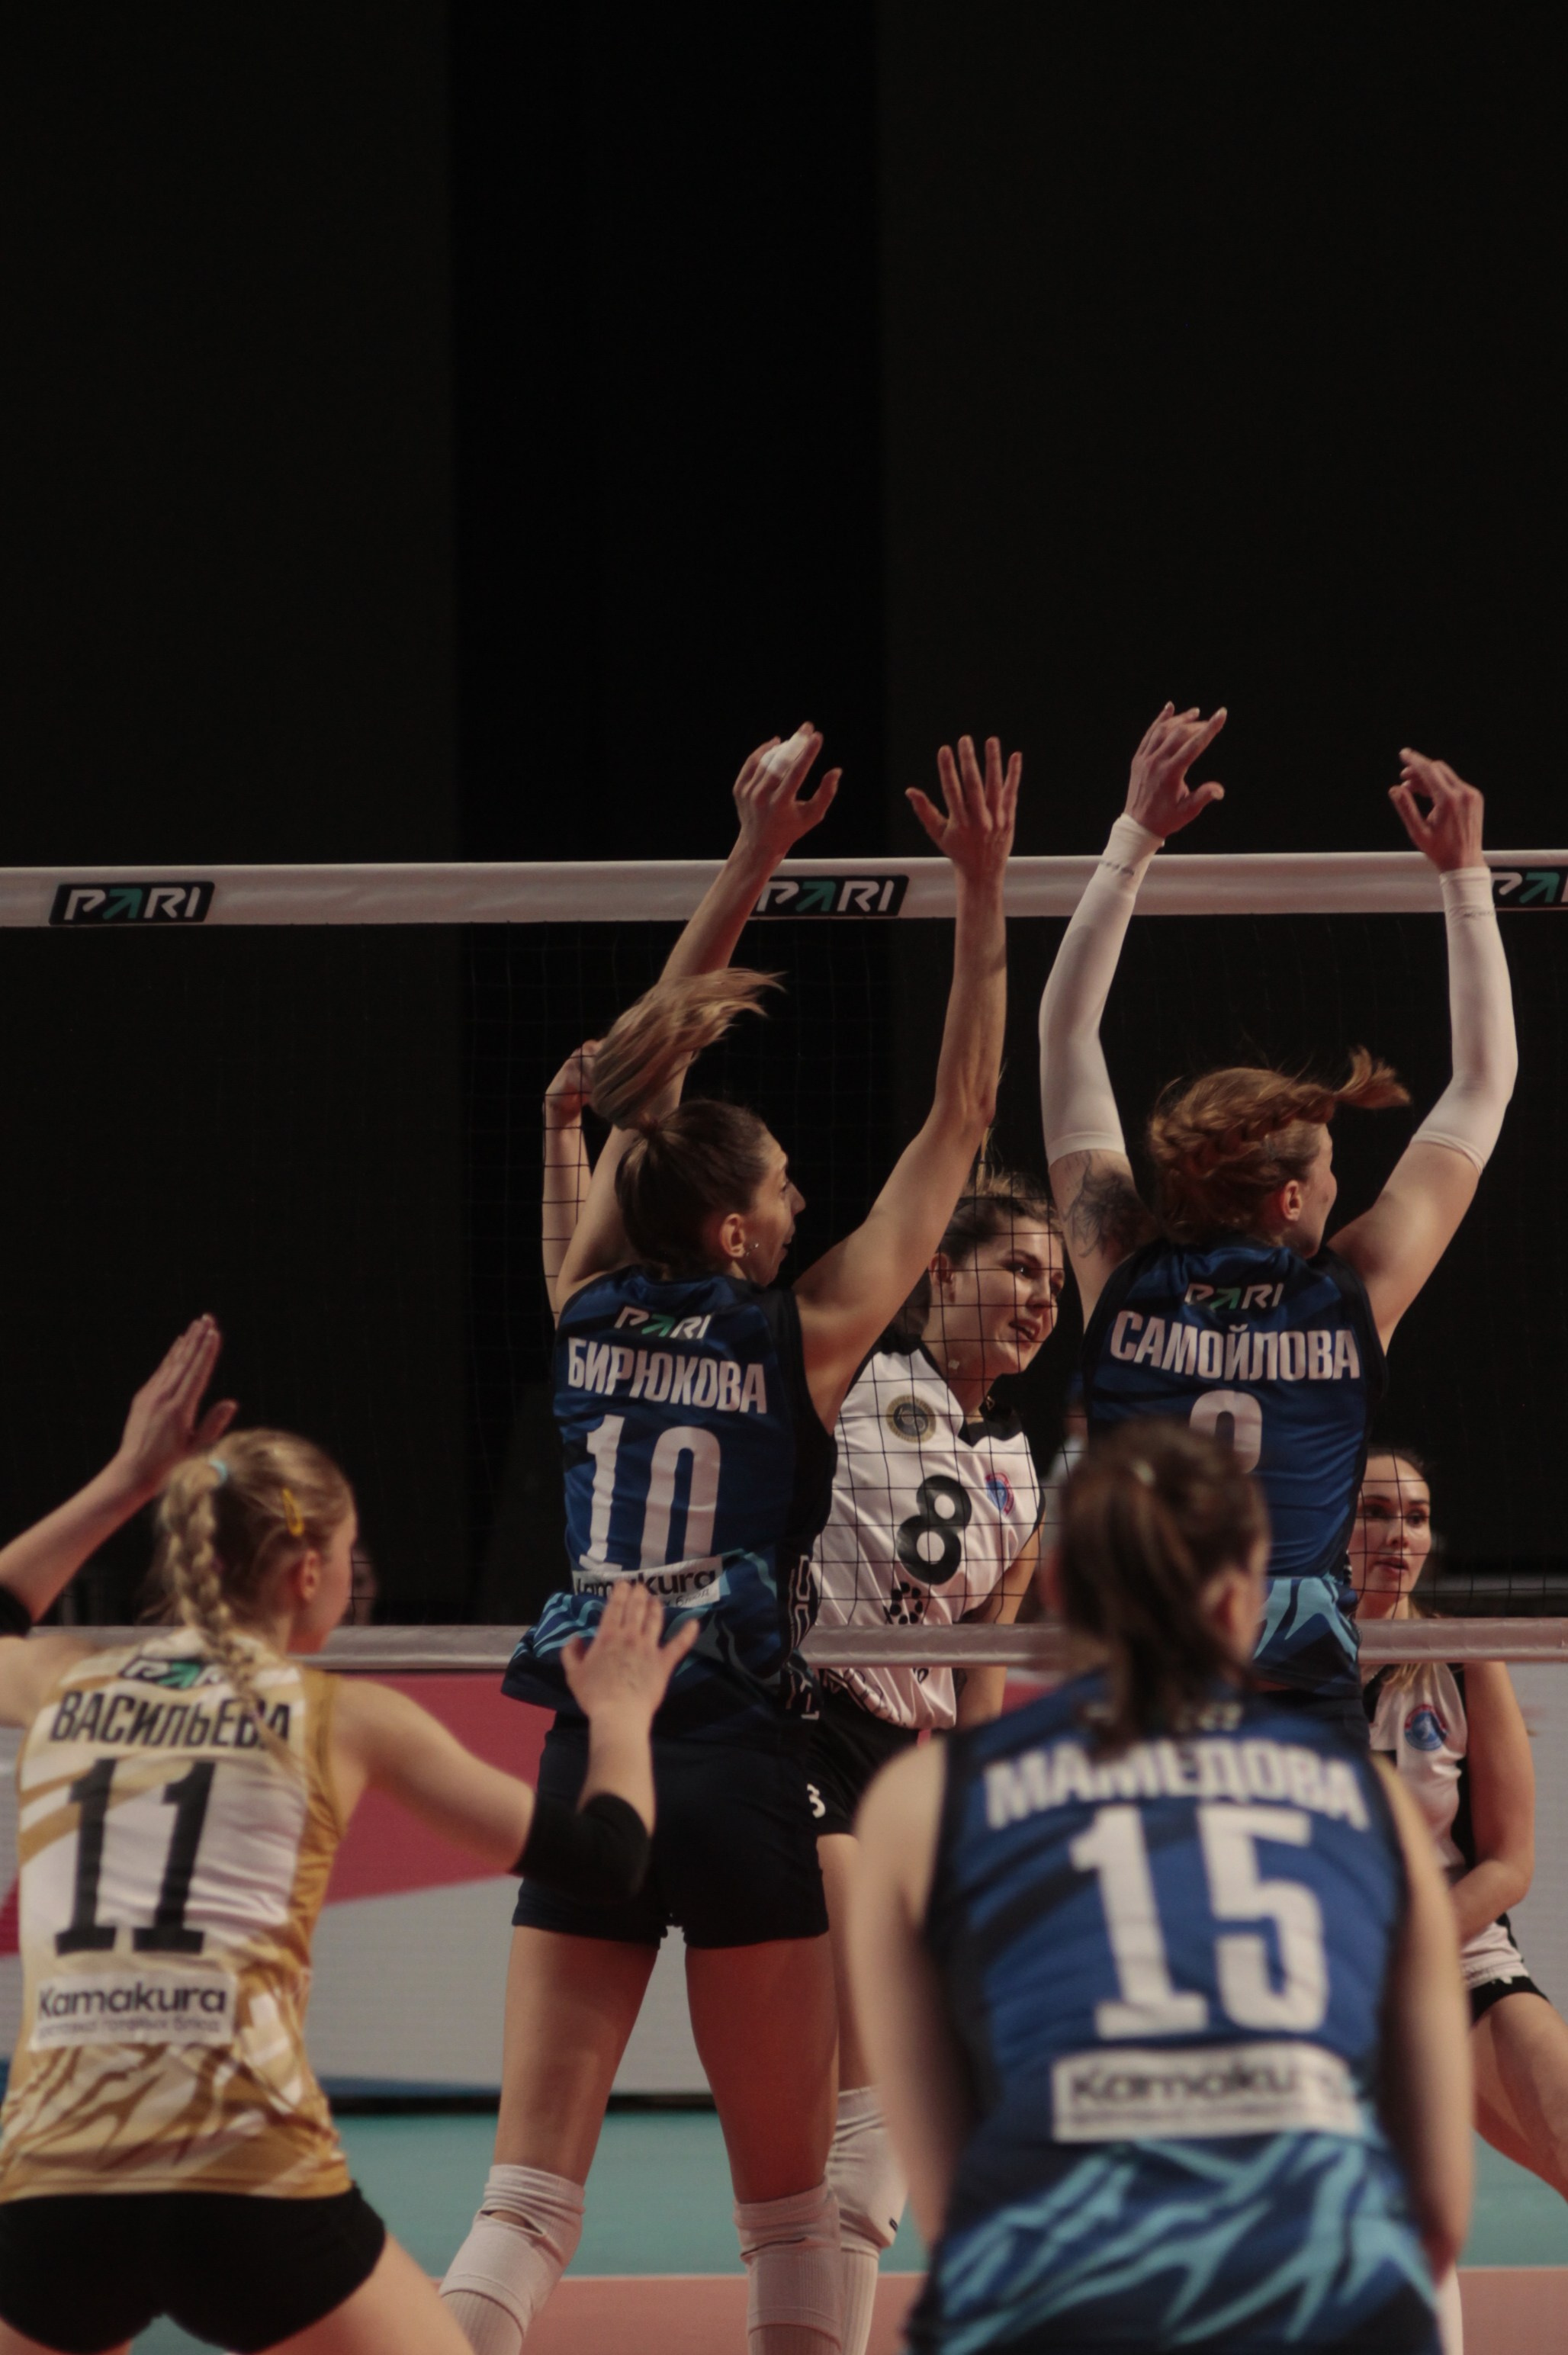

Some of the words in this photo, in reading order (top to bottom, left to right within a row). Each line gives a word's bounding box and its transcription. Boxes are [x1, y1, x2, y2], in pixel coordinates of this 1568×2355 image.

[64, 887, 201, 920] PARI
[756, 880, 895, 913] PARI
[1491, 872, 1568, 904] PA
[614, 1306, 713, 1340] PARI
[1184, 1283, 1285, 1311] PARI
[1110, 1309, 1361, 1381] САМОЙЛОВА
[567, 1336, 768, 1415] БИРЮКОВА
[578, 1412, 722, 1571] 10
[895, 1475, 972, 1586] 8
[48, 1690, 291, 1750] ВАСИЛЬЕВА
[55, 1757, 217, 1955] 11
[1069, 1803, 1331, 2040] 15
[40, 1981, 227, 2018] Kamakura
